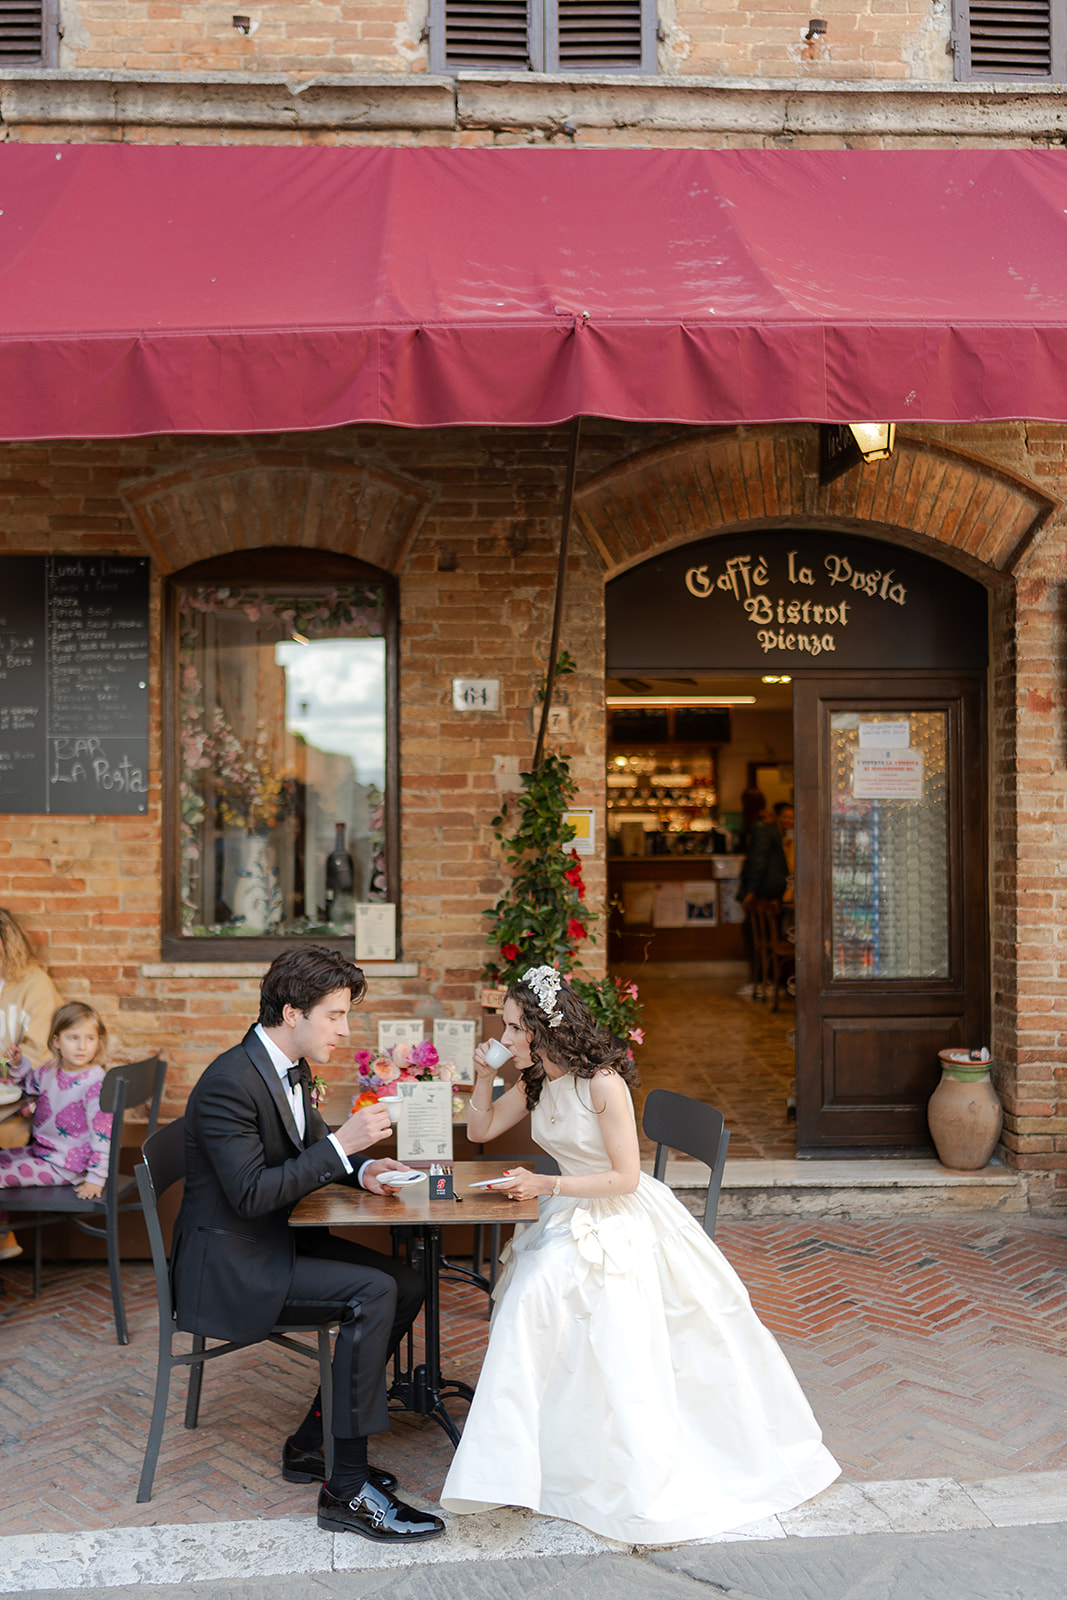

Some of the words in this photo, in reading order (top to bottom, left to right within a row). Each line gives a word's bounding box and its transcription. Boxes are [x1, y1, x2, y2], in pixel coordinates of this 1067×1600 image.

[684, 555, 770, 601] Caffè
[787, 550, 816, 586] la
[824, 553, 908, 606] Posta
[743, 595, 852, 626] Bistrot
[757, 629, 837, 656] Pienza
[53, 737, 106, 760] BAR
[51, 760, 87, 784] LA
